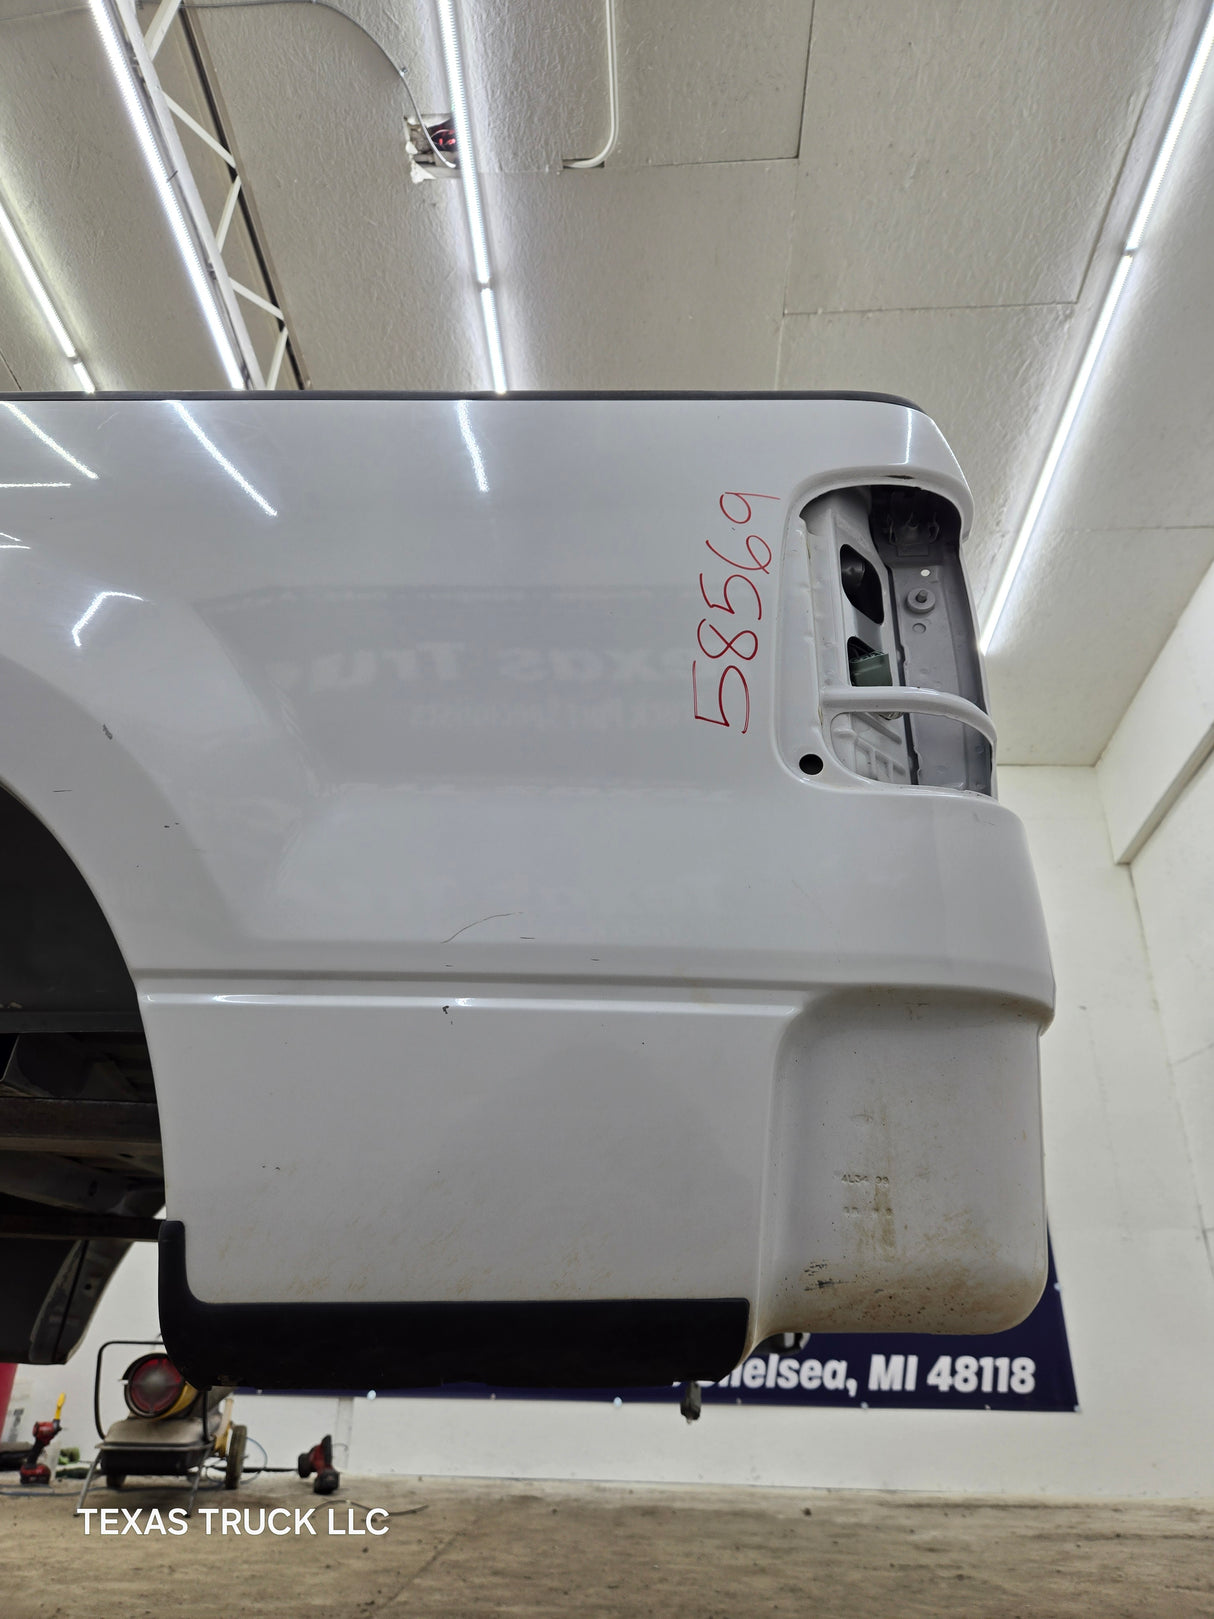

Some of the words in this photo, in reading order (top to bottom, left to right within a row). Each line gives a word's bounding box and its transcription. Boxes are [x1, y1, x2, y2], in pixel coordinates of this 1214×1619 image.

[692, 491, 781, 734] 58569
[868, 1354, 918, 1391] MI
[926, 1355, 1036, 1394] 48118
